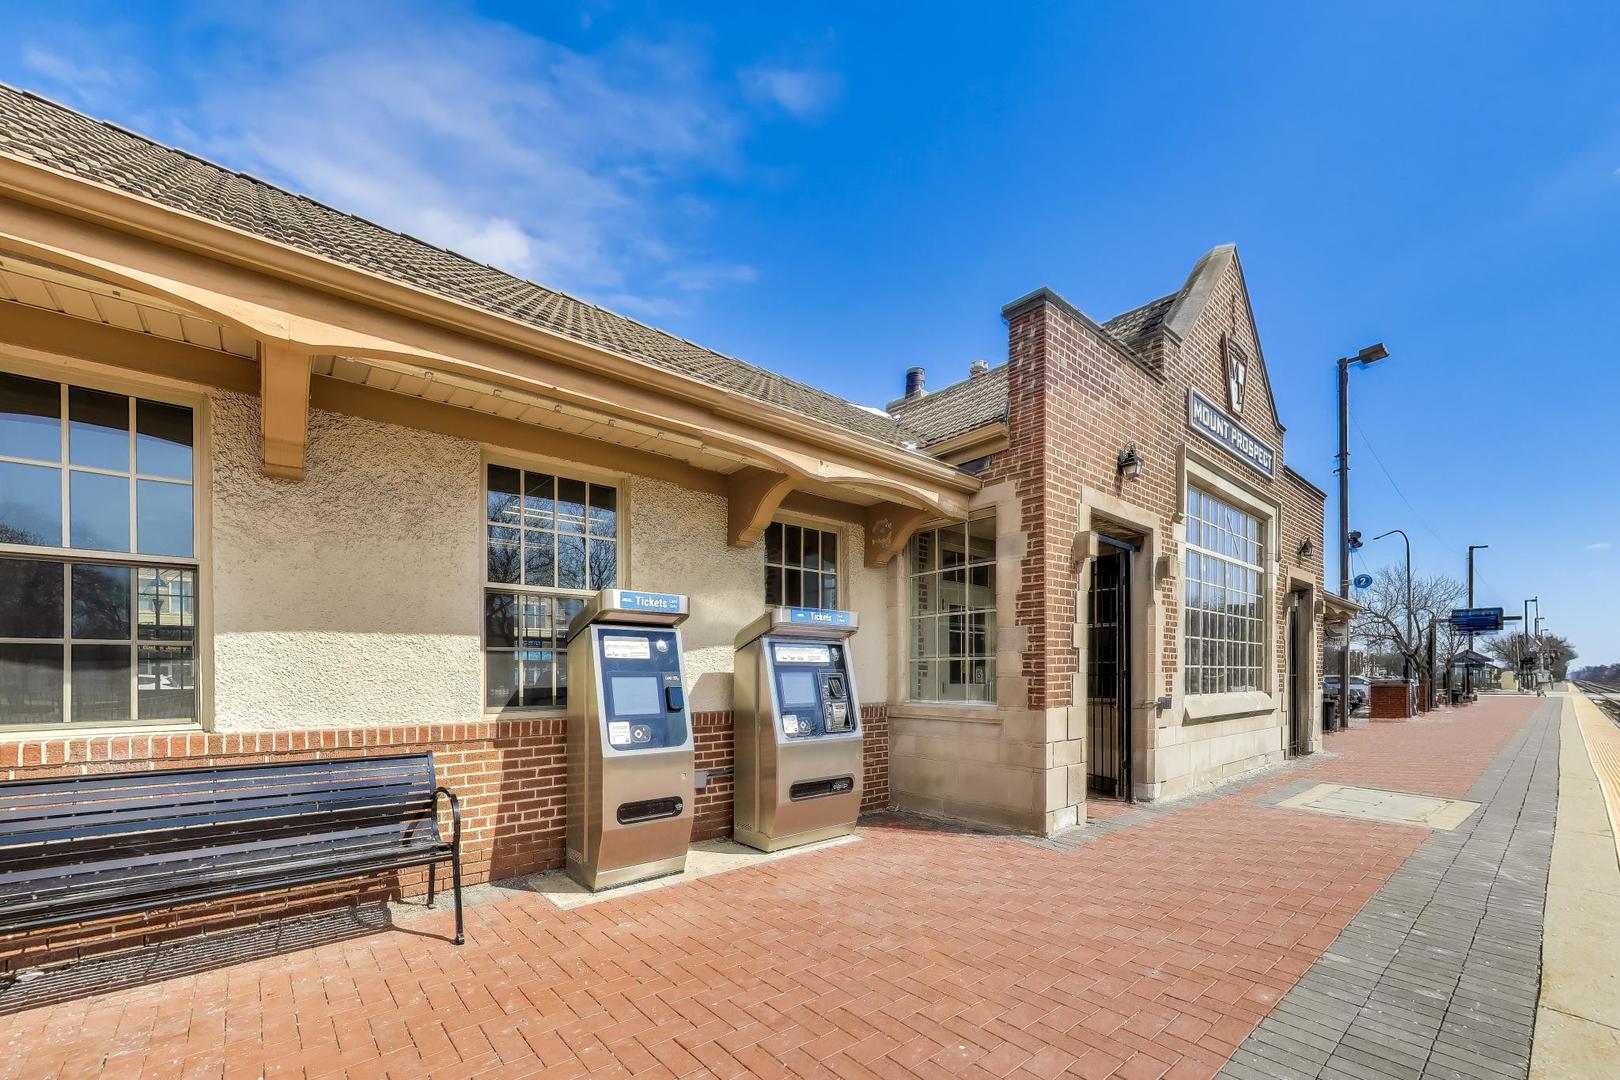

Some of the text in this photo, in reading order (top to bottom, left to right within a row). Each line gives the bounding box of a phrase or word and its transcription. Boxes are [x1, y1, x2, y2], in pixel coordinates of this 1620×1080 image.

[1194, 400, 1272, 469] MOUNT PROSPECT
[1359, 577, 1367, 586] 2
[636, 596, 668, 608] Tickets
[810, 612, 832, 622] Tickets
